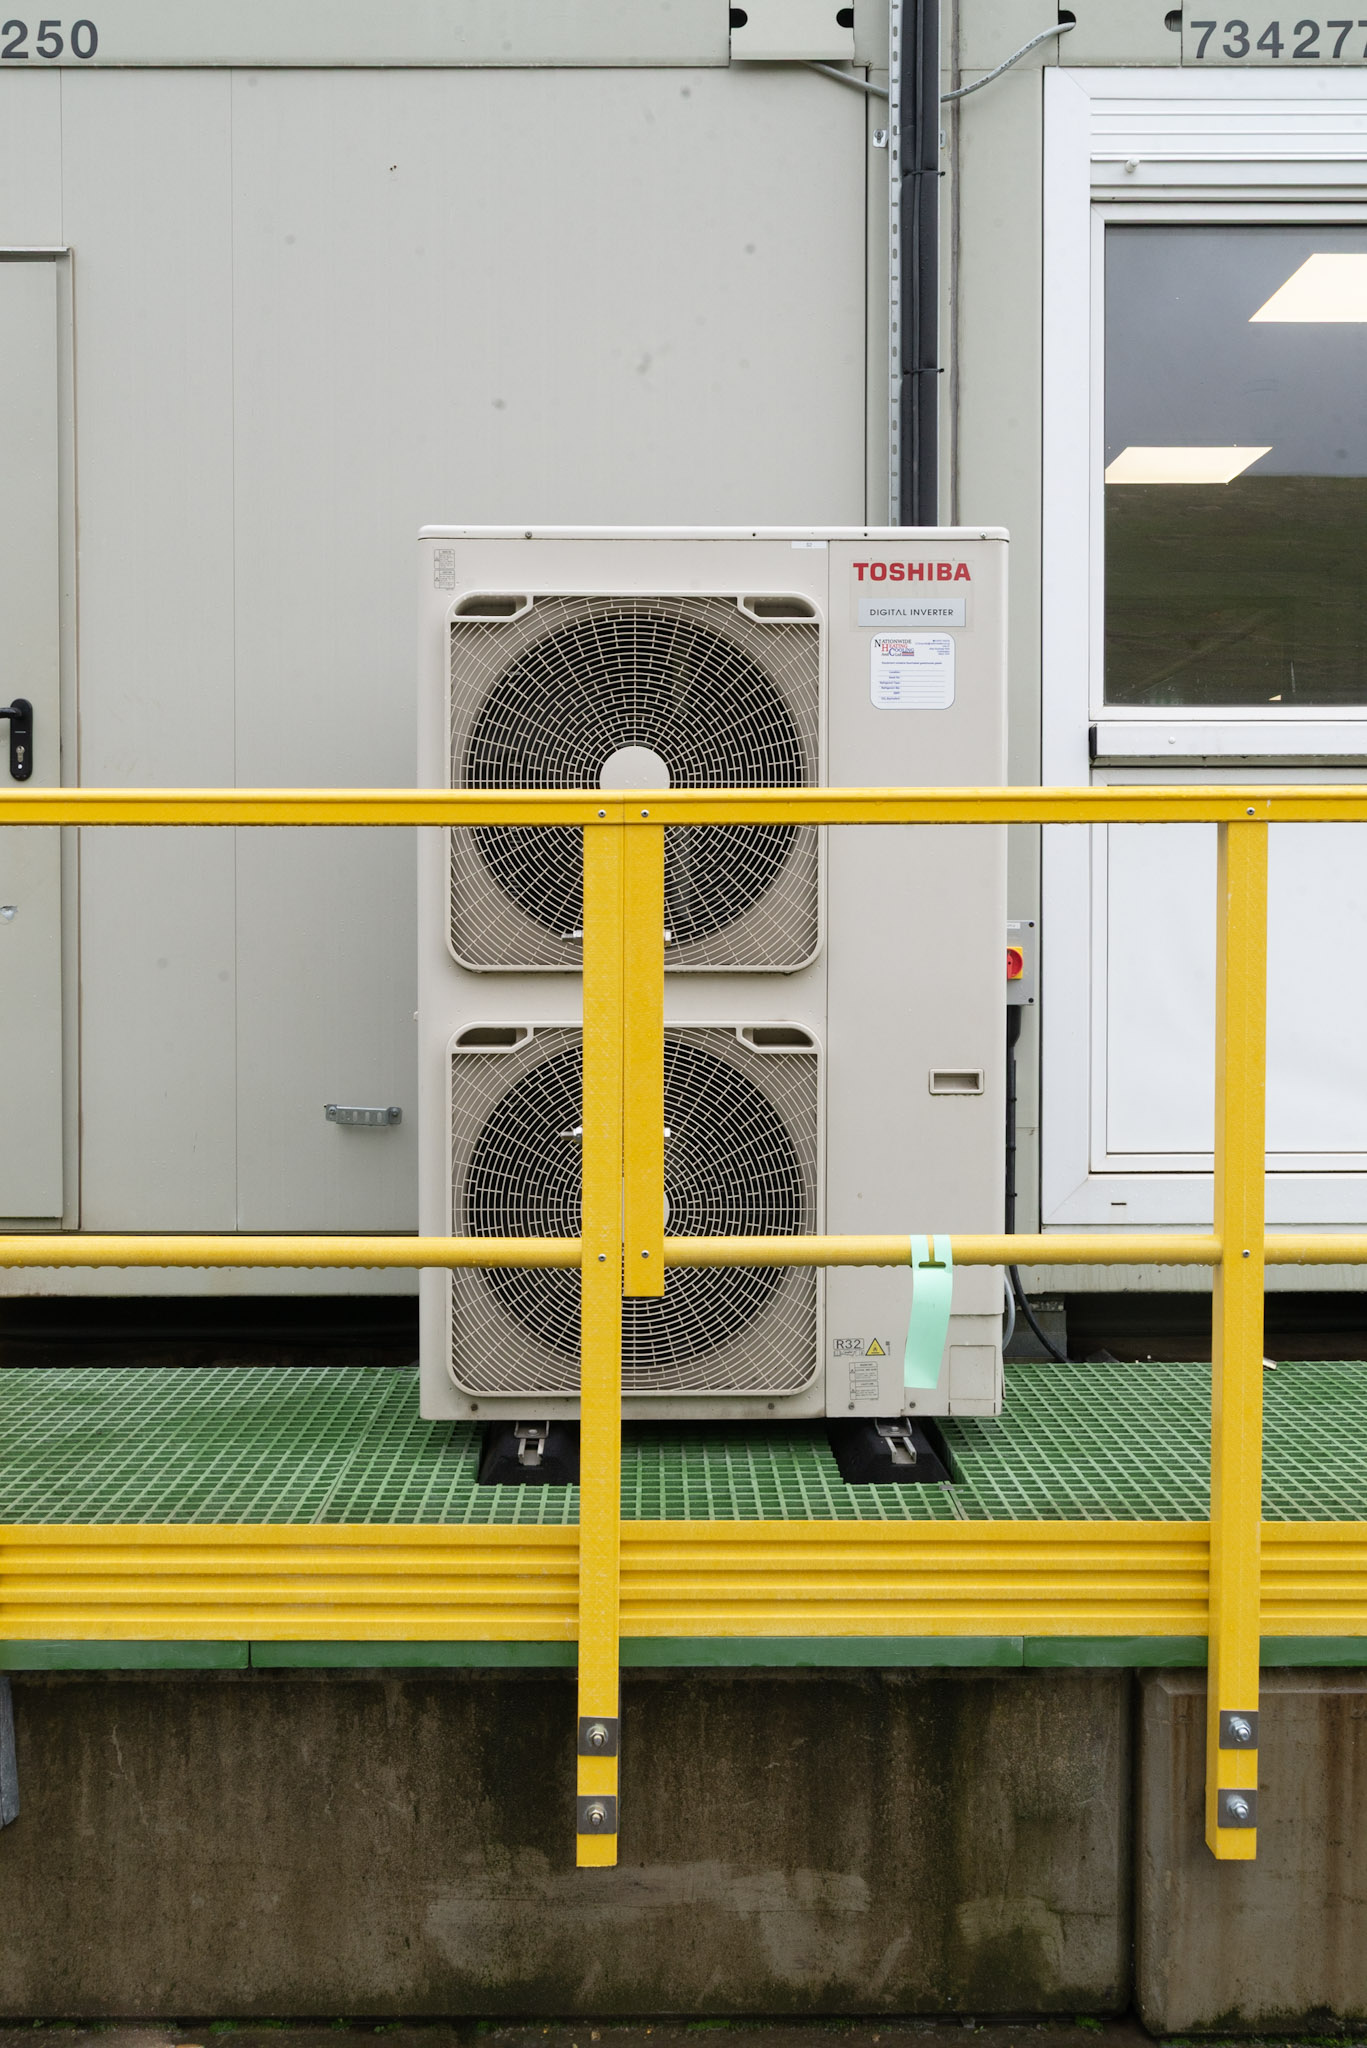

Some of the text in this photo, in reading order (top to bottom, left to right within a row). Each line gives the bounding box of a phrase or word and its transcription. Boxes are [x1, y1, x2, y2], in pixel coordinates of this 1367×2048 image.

[1, 19, 98, 59] 250
[852, 562, 971, 581] TOSHIBA
[869, 608, 954, 616] DIGITAL INVERTER
[836, 1339, 861, 1349] R32
